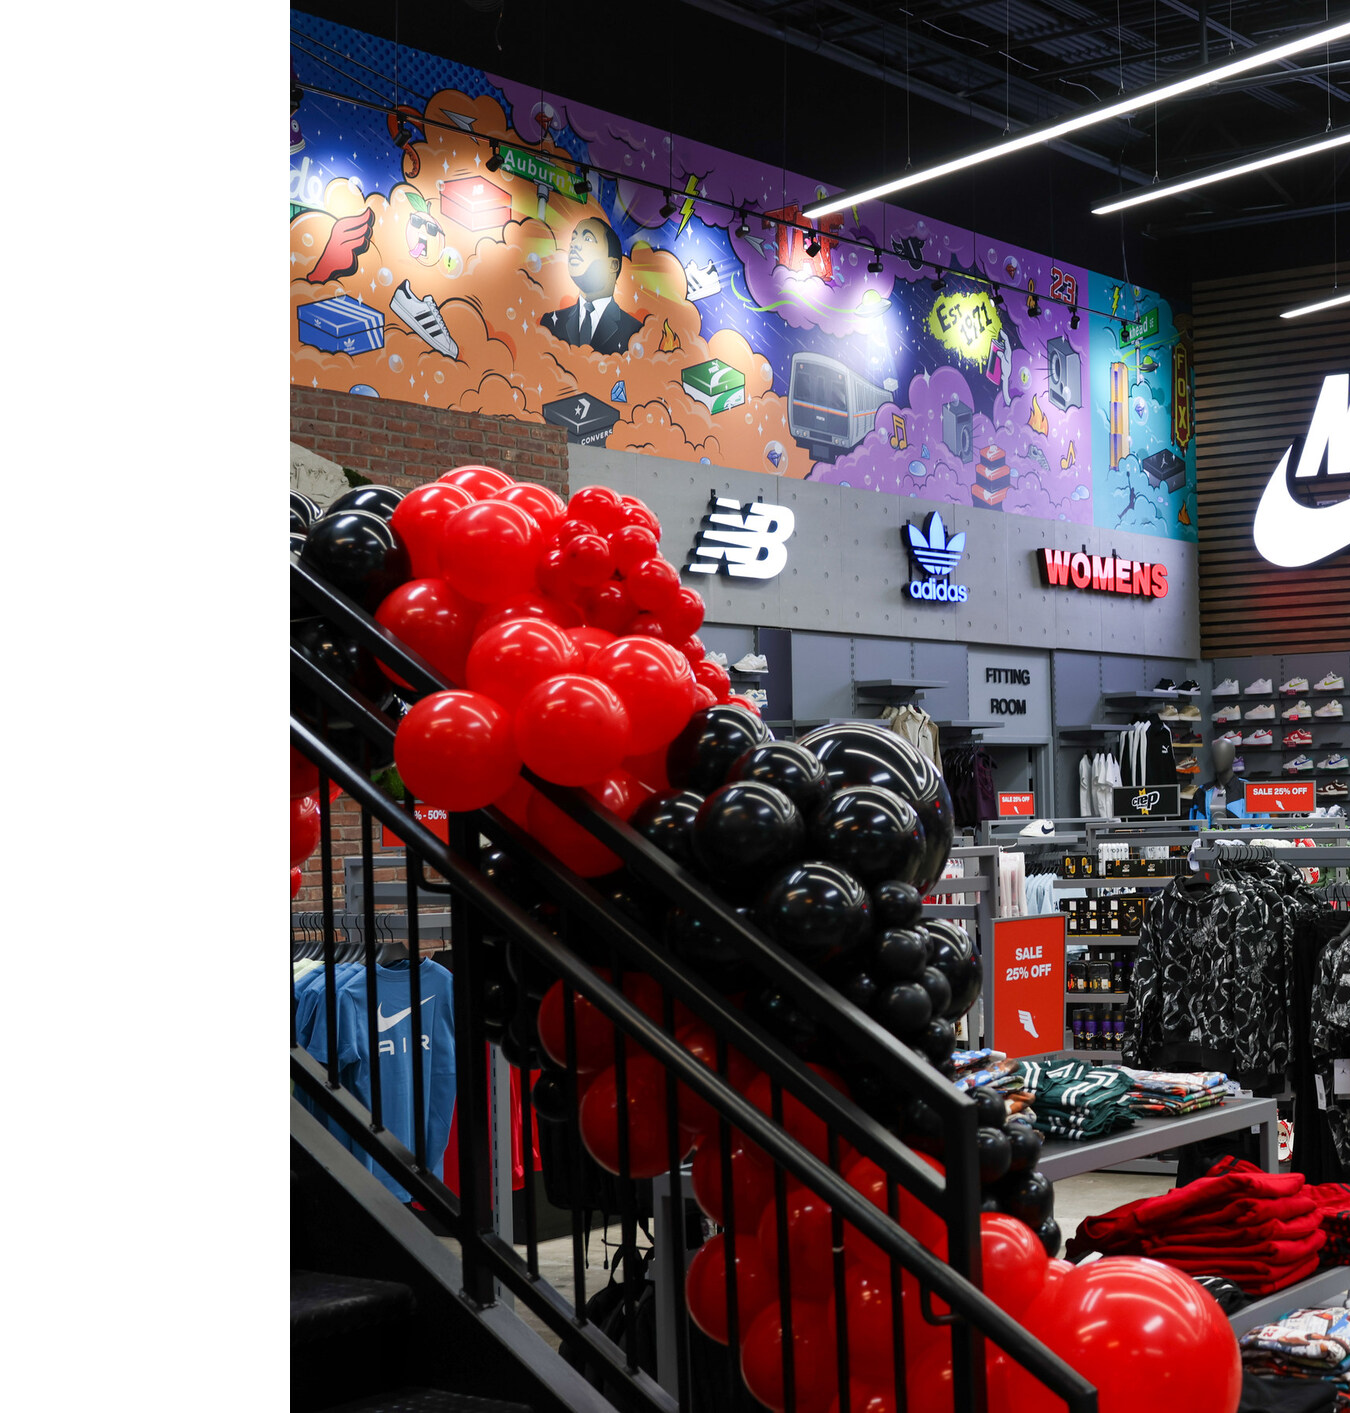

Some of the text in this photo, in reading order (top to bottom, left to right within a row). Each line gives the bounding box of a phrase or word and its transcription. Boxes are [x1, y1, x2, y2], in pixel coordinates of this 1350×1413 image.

[504, 150, 565, 188] Auburn
[1050, 267, 1078, 306] 23
[1176, 353, 1188, 430] FOX
[1043, 547, 1169, 599] WOMENS
[909, 578, 968, 602] adidas
[985, 667, 1031, 686] FITTING
[990, 698, 1027, 715] ROOM
[1131, 790, 1160, 810] crep
[1252, 787, 1308, 796] SALE 25% OFF
[427, 809, 447, 820] 50%
[1015, 945, 1043, 961] SALE
[1005, 963, 1052, 982] 25% OFF
[378, 1034, 431, 1056] AIR
